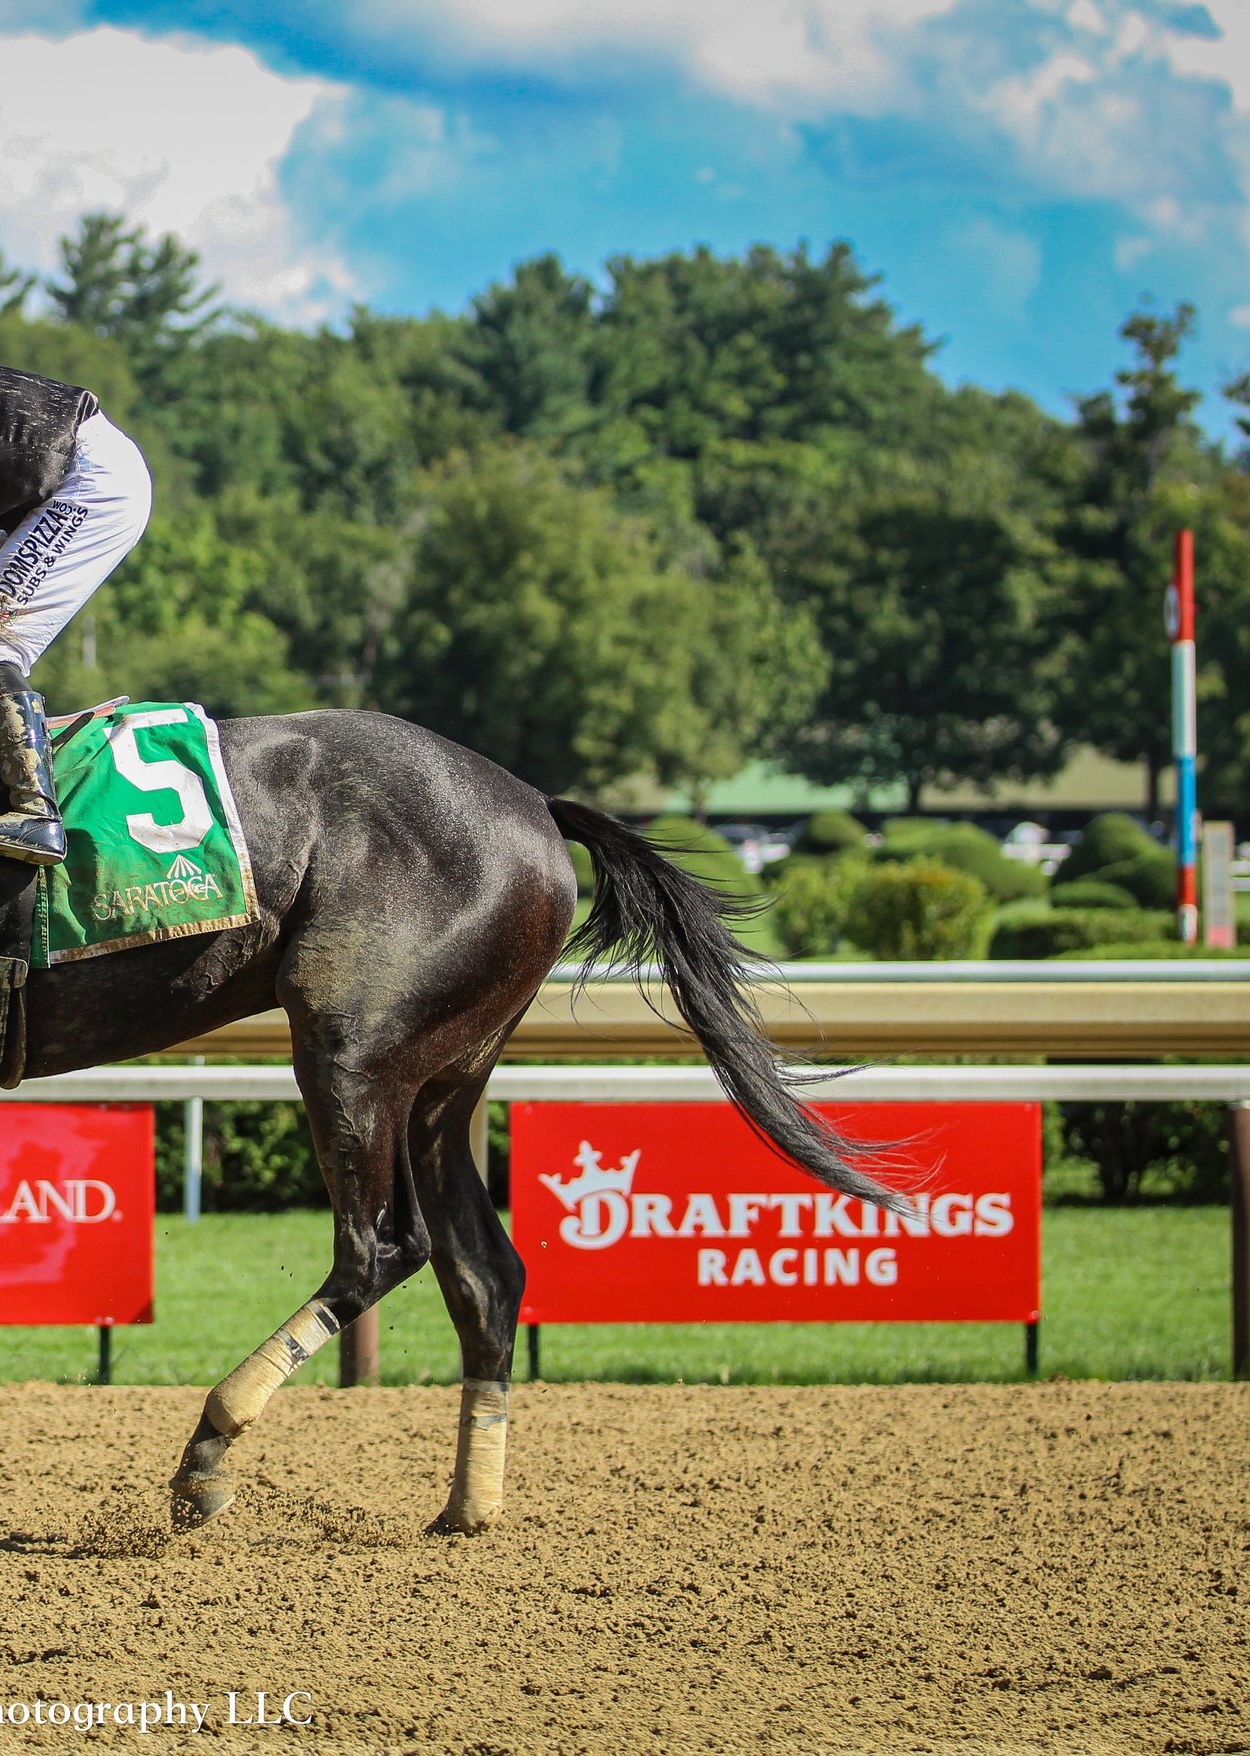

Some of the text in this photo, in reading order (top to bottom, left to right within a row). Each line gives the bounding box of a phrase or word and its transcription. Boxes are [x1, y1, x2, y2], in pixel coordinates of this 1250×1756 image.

[17, 506, 88, 605] SUBS & WINGS
[102, 708, 214, 854] 5
[558, 1188, 1015, 1250] DRAFTKINGS
[697, 1247, 899, 1287] RACING
